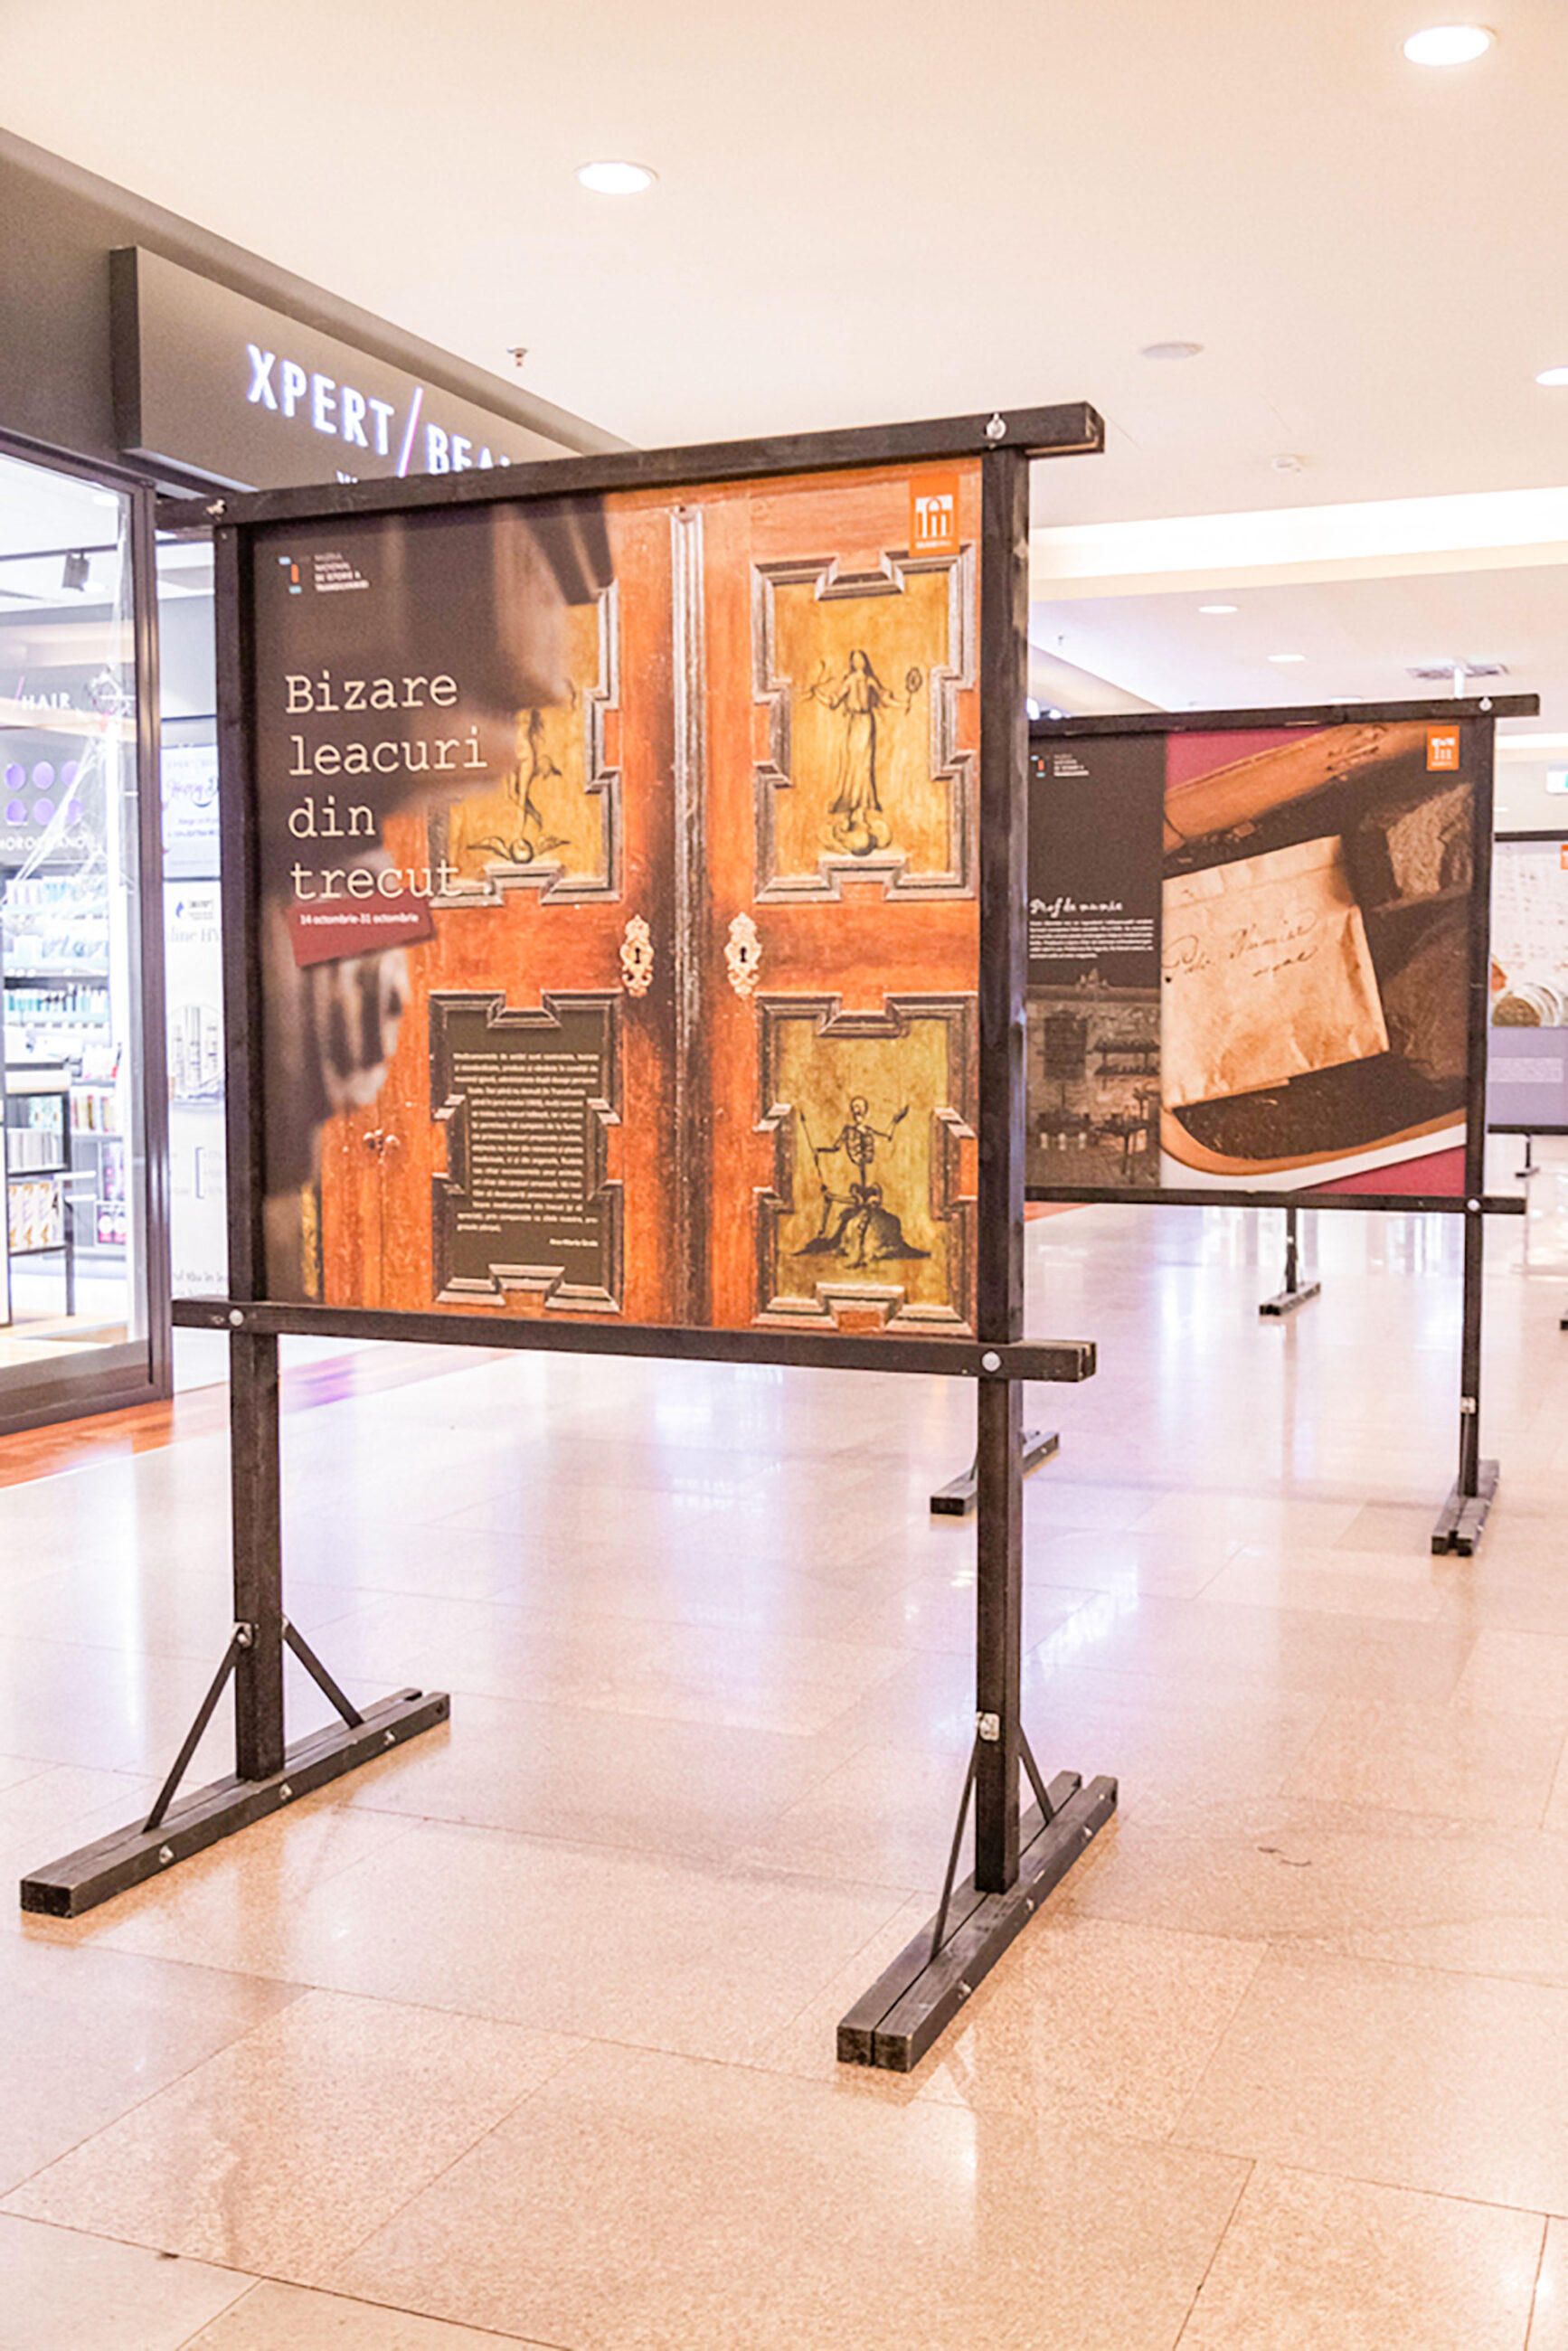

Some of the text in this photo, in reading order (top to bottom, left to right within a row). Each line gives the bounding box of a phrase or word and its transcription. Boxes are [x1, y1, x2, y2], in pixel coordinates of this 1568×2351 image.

[285, 670, 458, 713] Bizare
[288, 725, 488, 776] leacuri
[288, 795, 376, 839] din
[290, 859, 463, 901] trecut
